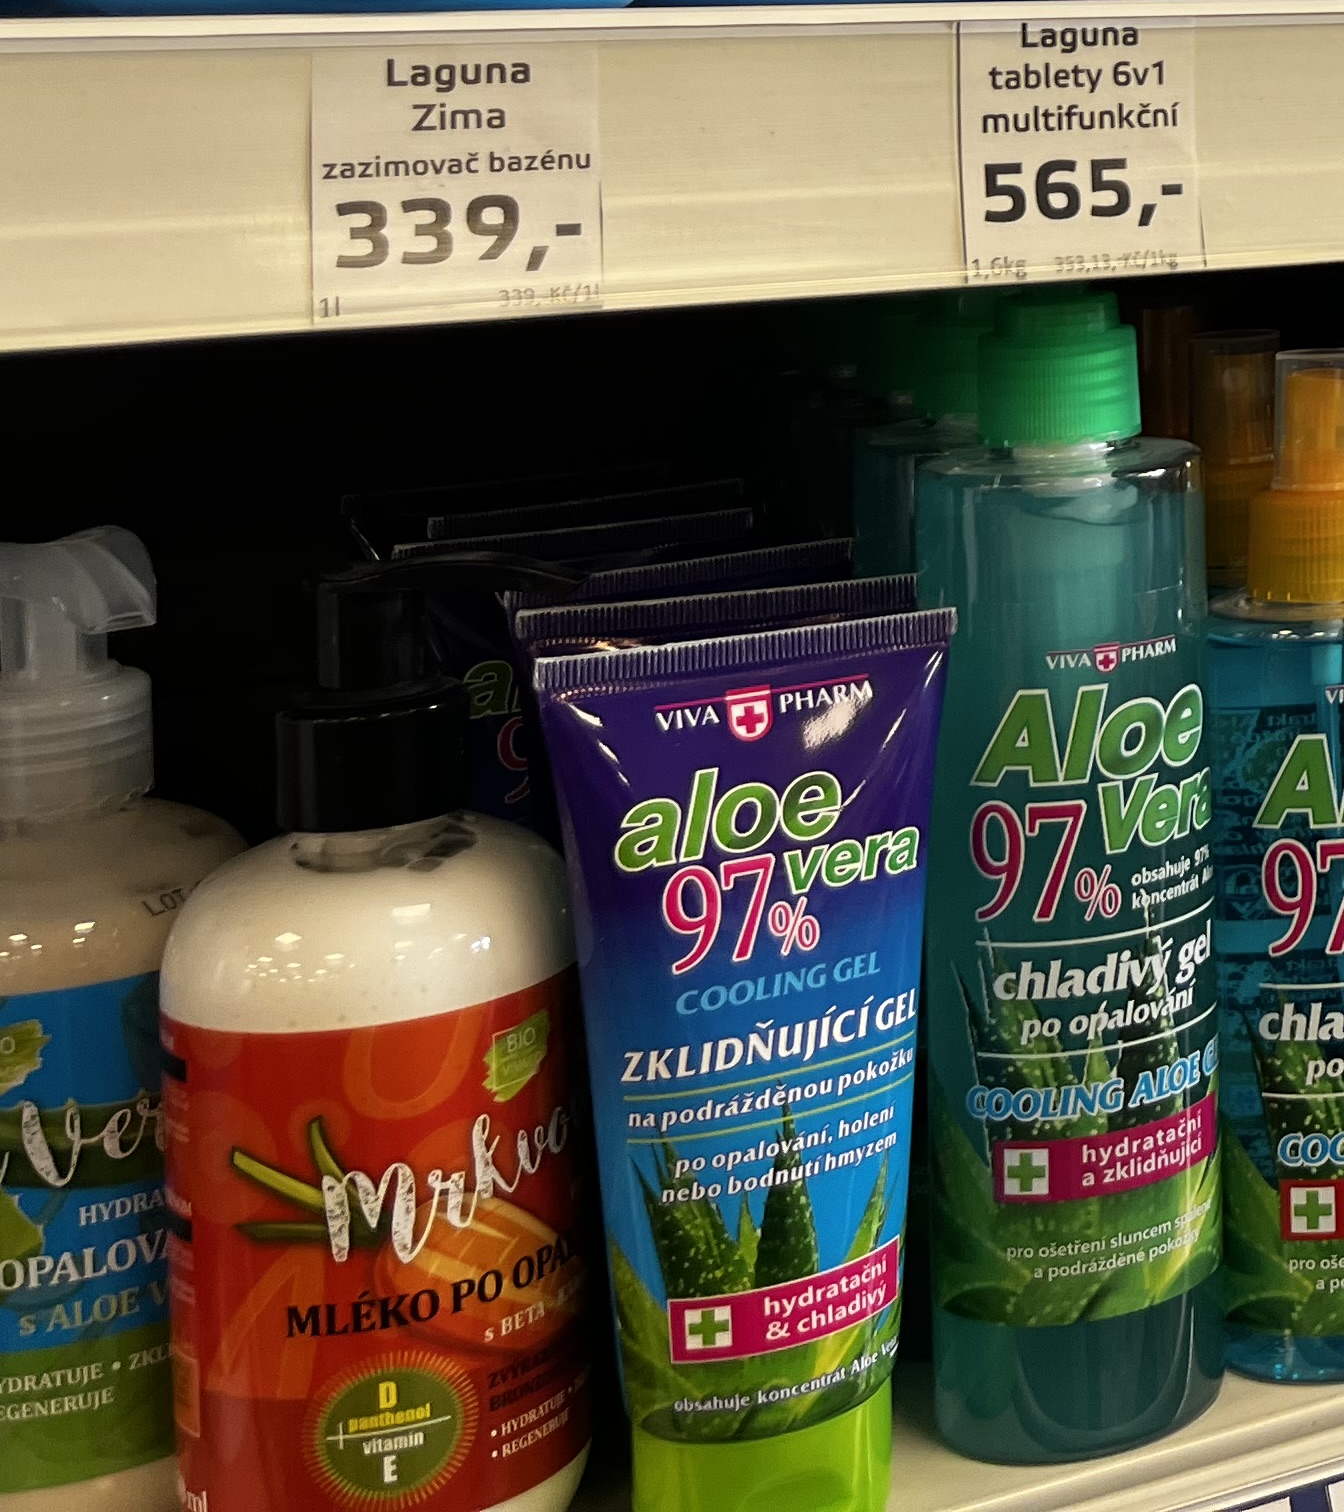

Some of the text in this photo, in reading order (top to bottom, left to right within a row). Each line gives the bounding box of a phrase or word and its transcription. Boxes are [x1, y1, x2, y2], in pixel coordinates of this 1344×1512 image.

[1021, 22, 1140, 53] Laguna
[988, 60, 1165, 94] tablety 6v1
[411, 103, 507, 132] Zima
[982, 101, 1180, 134] multifunkční
[322, 149, 591, 180] zazimovač bazénu
[984, 157, 1184, 228] 565,-
[1046, 639, 1176, 670] VIVA PHARM
[655, 679, 873, 732] VIVA PHARM
[969, 683, 1204, 788] Aloe
[614, 767, 842, 872] aloe
[784, 826, 920, 895] vera
[675, 951, 881, 1015] COOLING GEL
[1068, 978, 1196, 1042] opalování
[627, 1044, 914, 1133] na podrážděnou pokožku
[1082, 1107, 1202, 1167] hydratační
[1102, 1132, 1202, 1184] zklidňující
[661, 1179, 722, 1206] nebo
[674, 1155, 707, 1179] po
[1038, 1234, 1107, 1259] ošetření
[1047, 1247, 1146, 1282] podrážděné
[287, 1269, 503, 1339] MLÉKO PO
[763, 1255, 887, 1318] hydratační
[797, 1281, 887, 1335] chladivý
[45, 1290, 141, 1336] ALOE
[673, 1367, 847, 1414] obsahuje koncentrát
